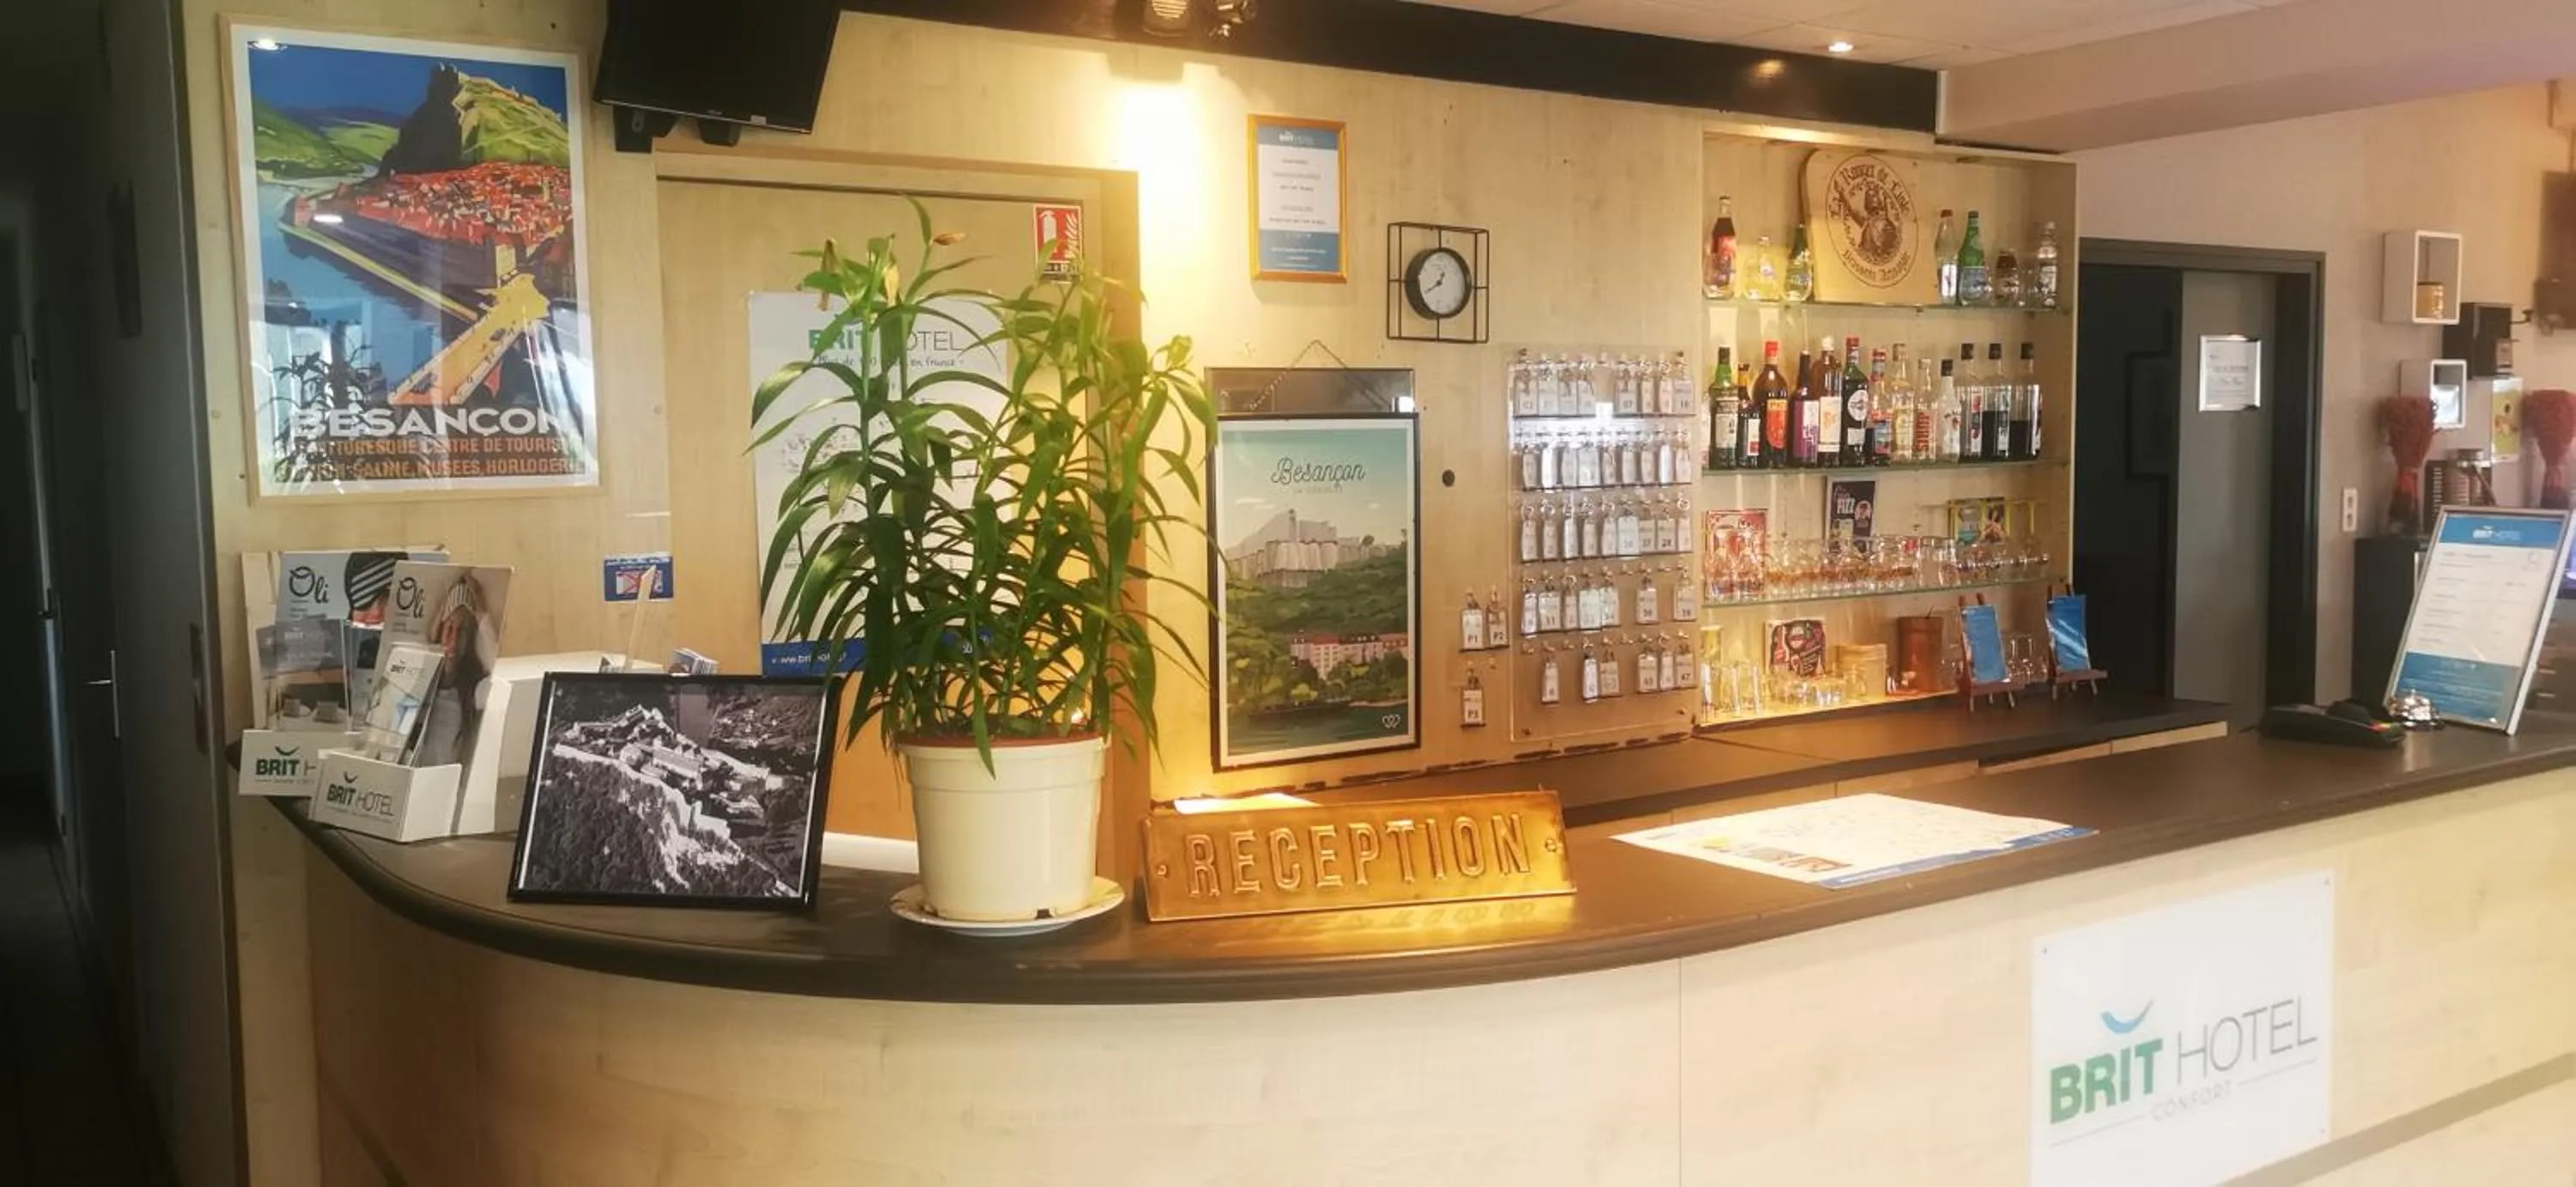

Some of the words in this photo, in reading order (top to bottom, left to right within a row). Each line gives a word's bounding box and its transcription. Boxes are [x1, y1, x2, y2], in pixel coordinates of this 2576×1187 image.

[809, 329, 871, 350] BRI
[897, 331, 963, 351] OTEL
[294, 407, 570, 436] BESANÇON
[483, 437, 501, 453] DE
[506, 436, 570, 453] TOURIS
[1271, 457, 1367, 488] Besançon
[289, 566, 330, 604] Oli
[396, 576, 426, 618] Oli
[1468, 634, 1478, 643] P1
[1494, 631, 1505, 641] P2
[256, 759, 299, 776] BRIT
[327, 783, 356, 806] BRIT
[357, 791, 395, 817] HOTEL
[1186, 813, 1533, 898] RECEPTION
[2050, 1038, 2163, 1124] BRIT
[2177, 995, 2318, 1086] HOTEL
